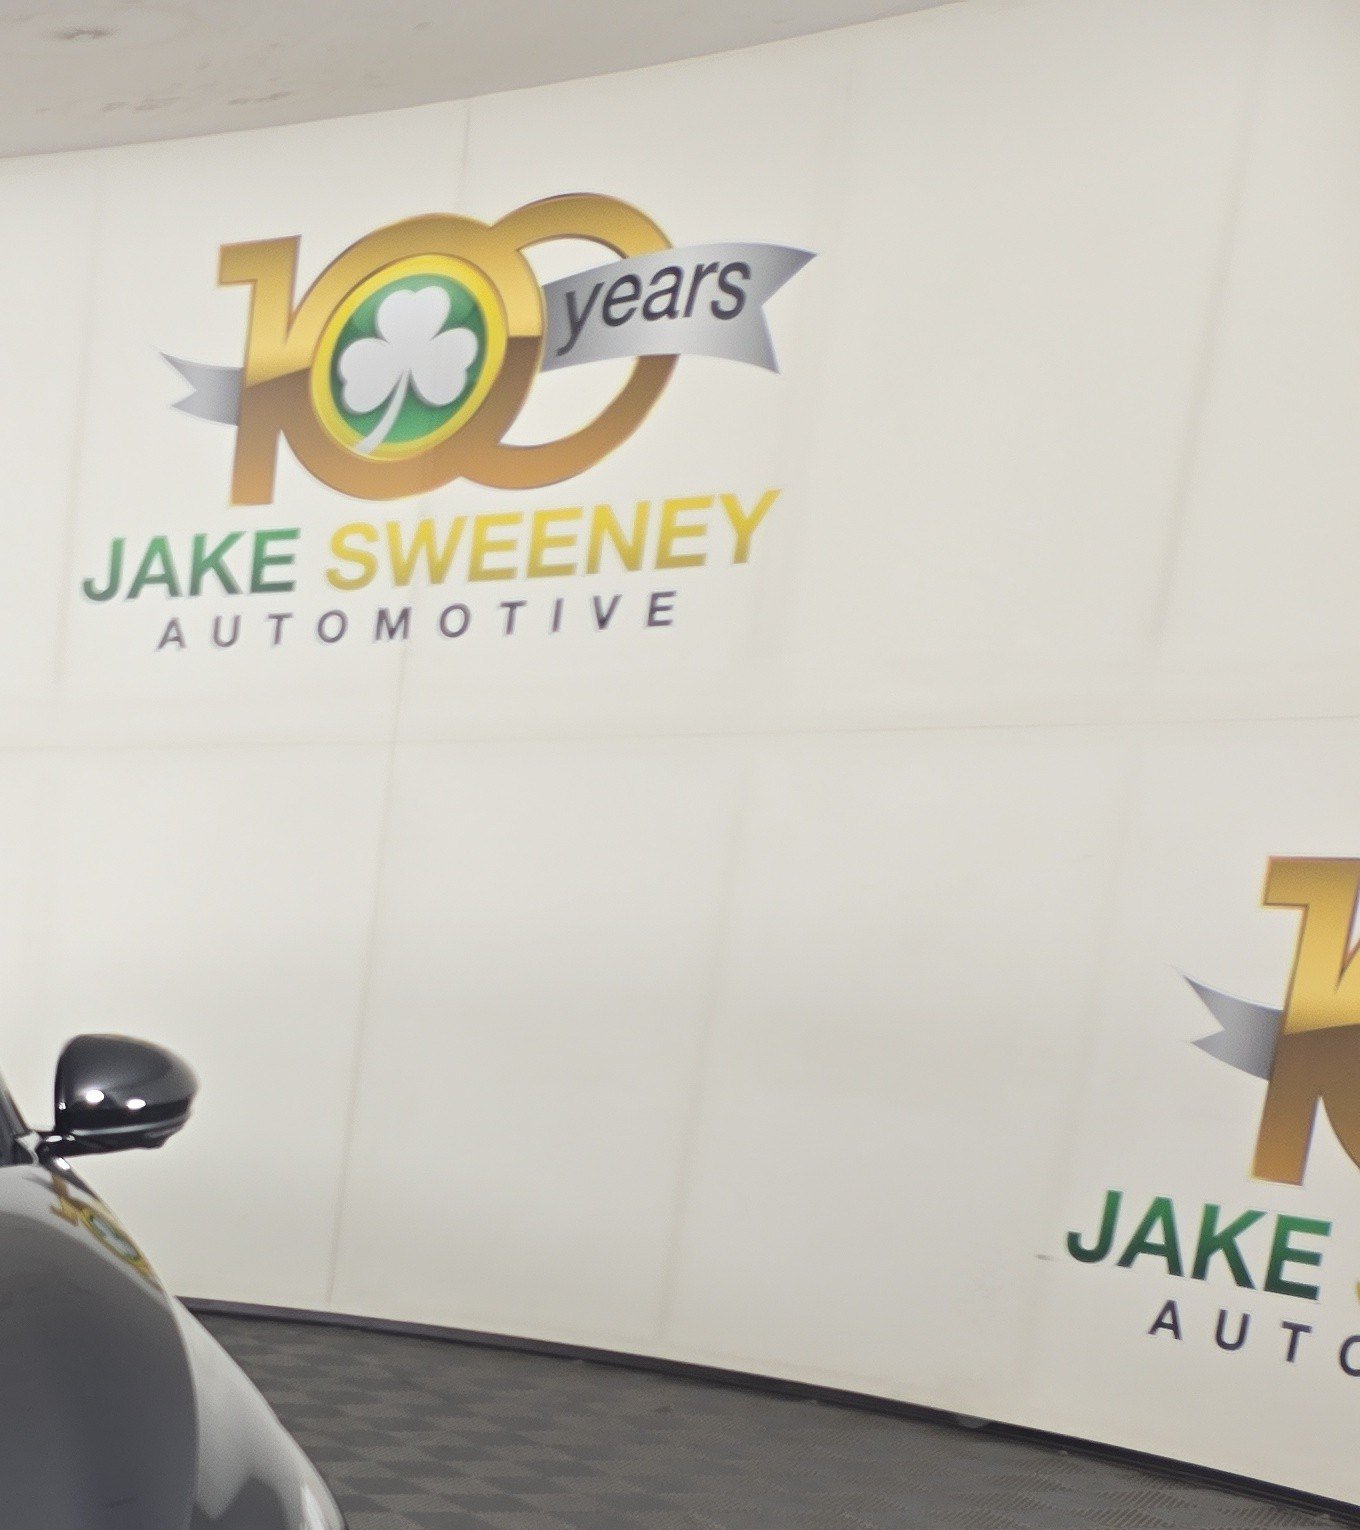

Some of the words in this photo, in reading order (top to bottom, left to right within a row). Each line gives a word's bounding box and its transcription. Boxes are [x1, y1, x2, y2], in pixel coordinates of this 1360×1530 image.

[555, 260, 751, 356] years
[82, 527, 302, 602] JAKE
[324, 488, 782, 592] SWEENEY
[155, 591, 677, 652] AUTOMOTIVE
[1066, 1189, 1332, 1301] JAKE
